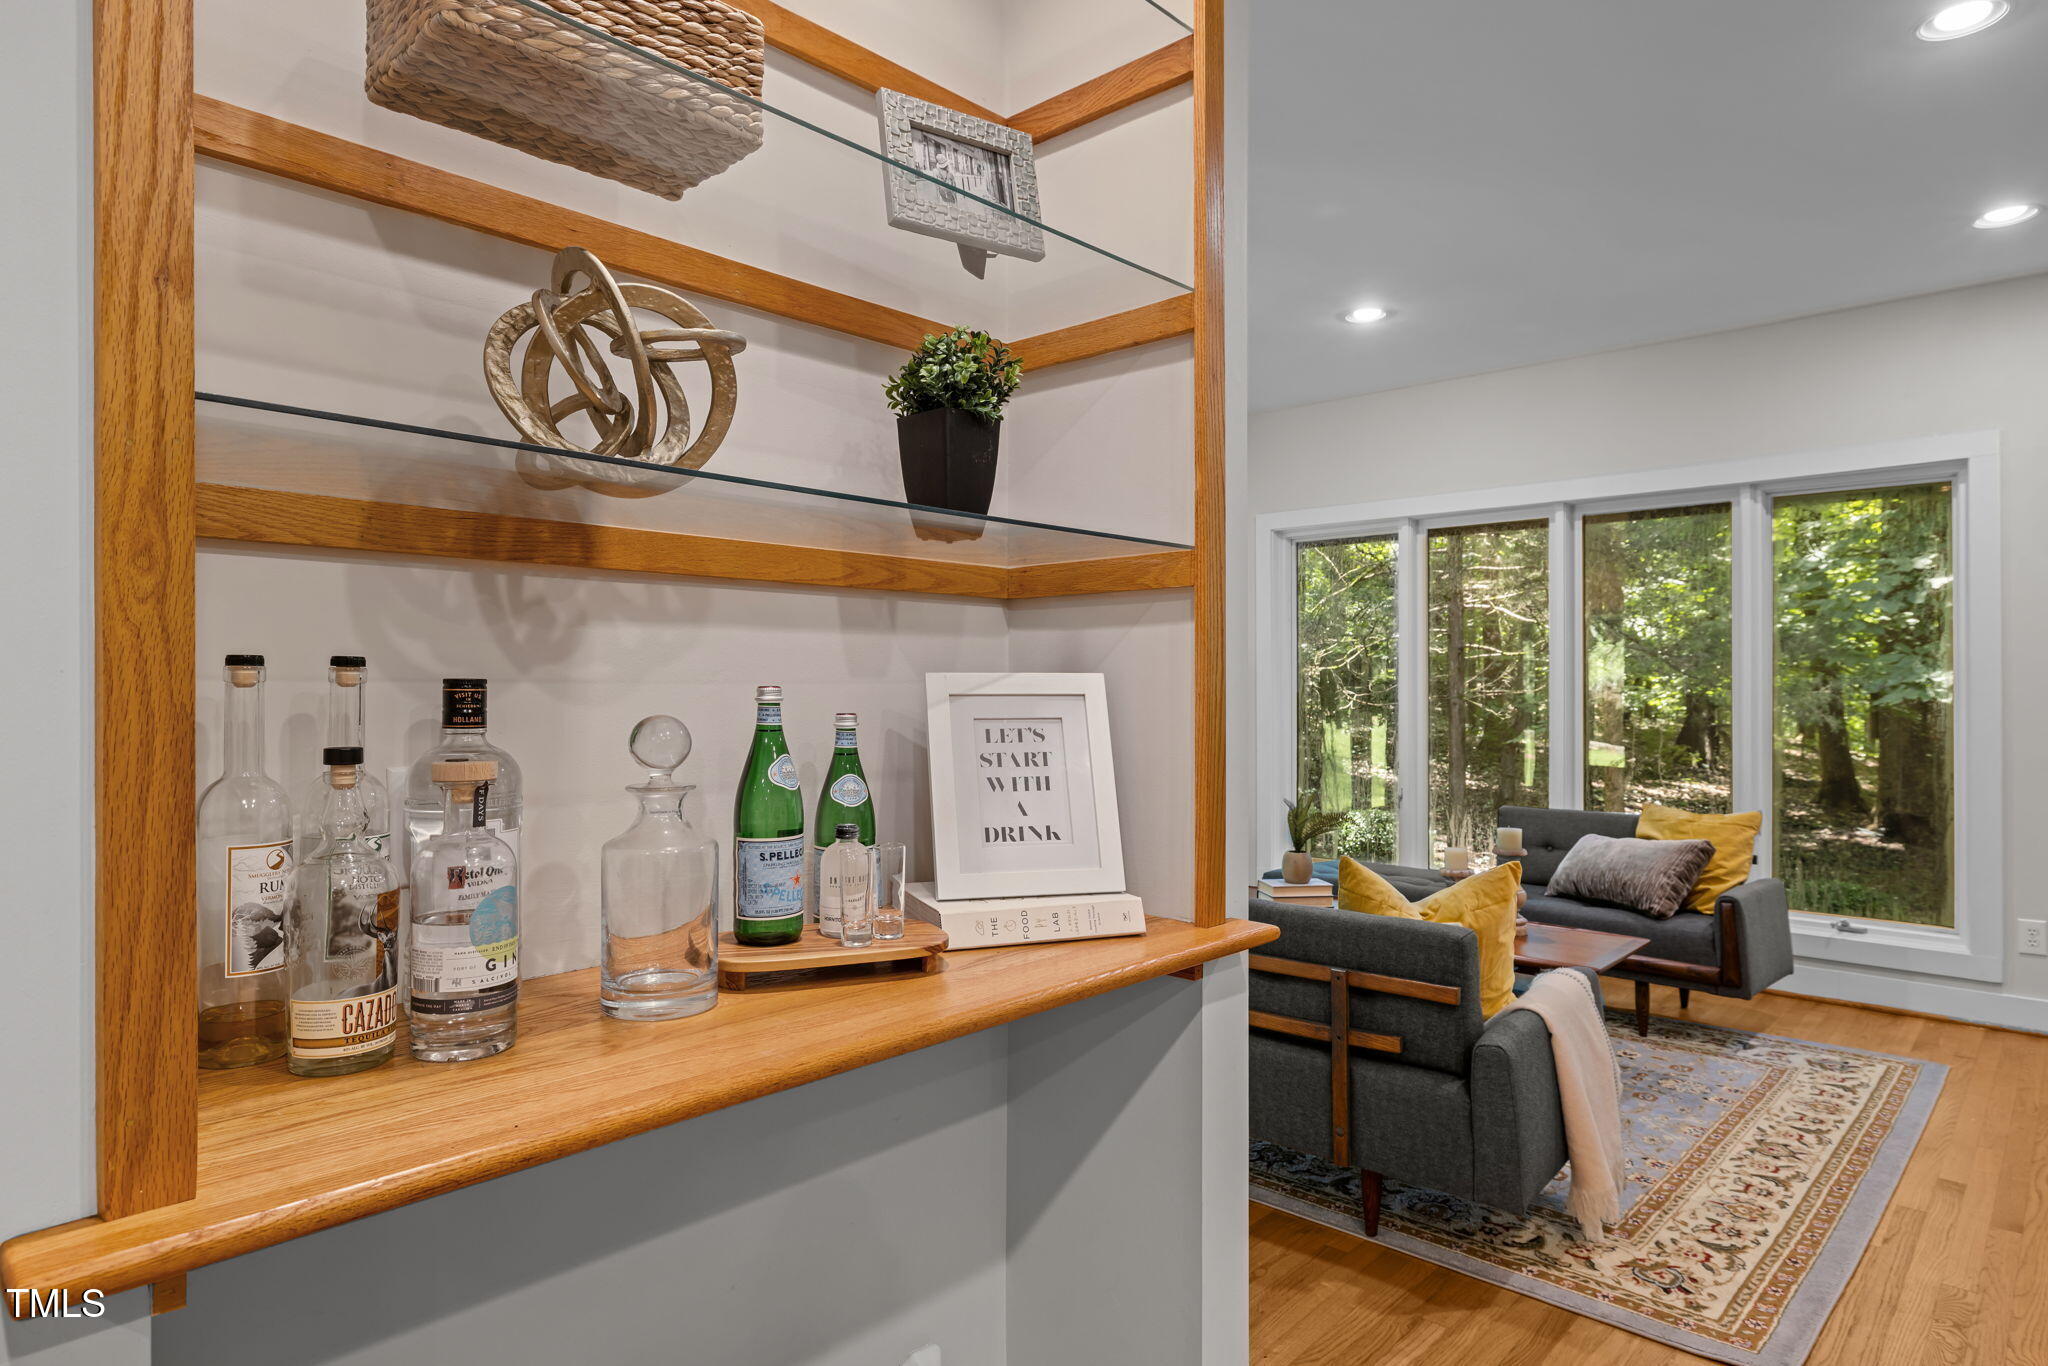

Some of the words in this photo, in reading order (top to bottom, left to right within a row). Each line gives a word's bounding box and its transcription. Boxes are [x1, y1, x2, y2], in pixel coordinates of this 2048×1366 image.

[985, 727, 1046, 743] LET'S
[980, 752, 1053, 768] START
[986, 775, 1051, 792] WITH
[477, 797, 486, 822] DAYS
[1016, 801, 1028, 817] A
[984, 825, 1062, 843] DRINK
[990, 917, 999, 938] THE
[1020, 910, 1030, 940] FOOD
[1052, 912, 1061, 932] LAB
[485, 950, 517, 972] GIN
[343, 1028, 387, 1045] TEQUILA
